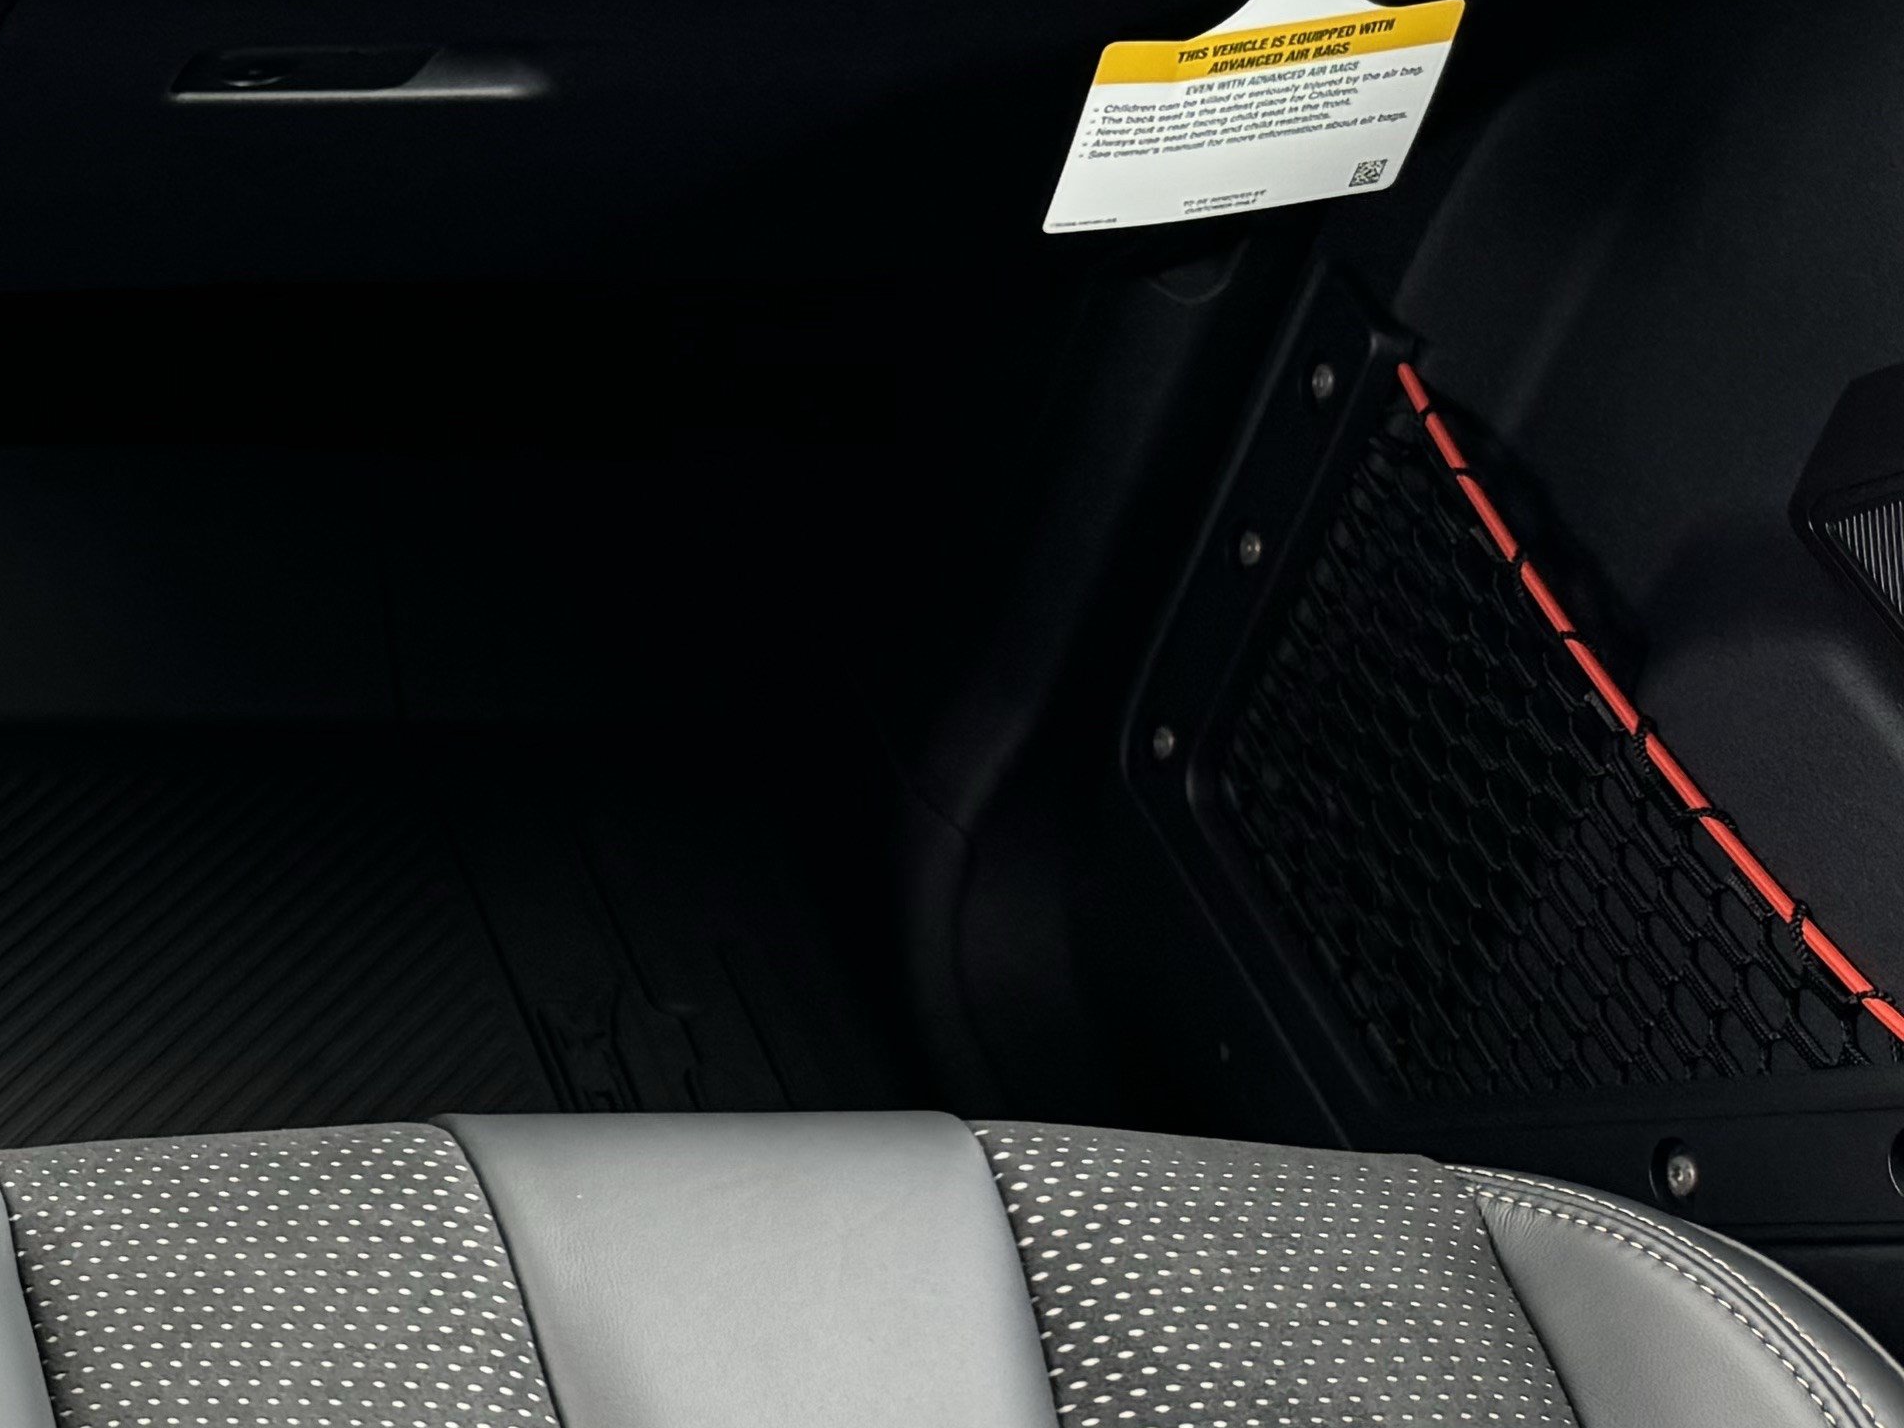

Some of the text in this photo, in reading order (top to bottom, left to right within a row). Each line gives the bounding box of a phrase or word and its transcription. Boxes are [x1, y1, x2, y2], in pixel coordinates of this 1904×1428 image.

[1178, 18, 1396, 64] THIS VEHICLE IS EQUIPPED WITH
[1207, 42, 1351, 75] ADVANCED AIR BAGS
